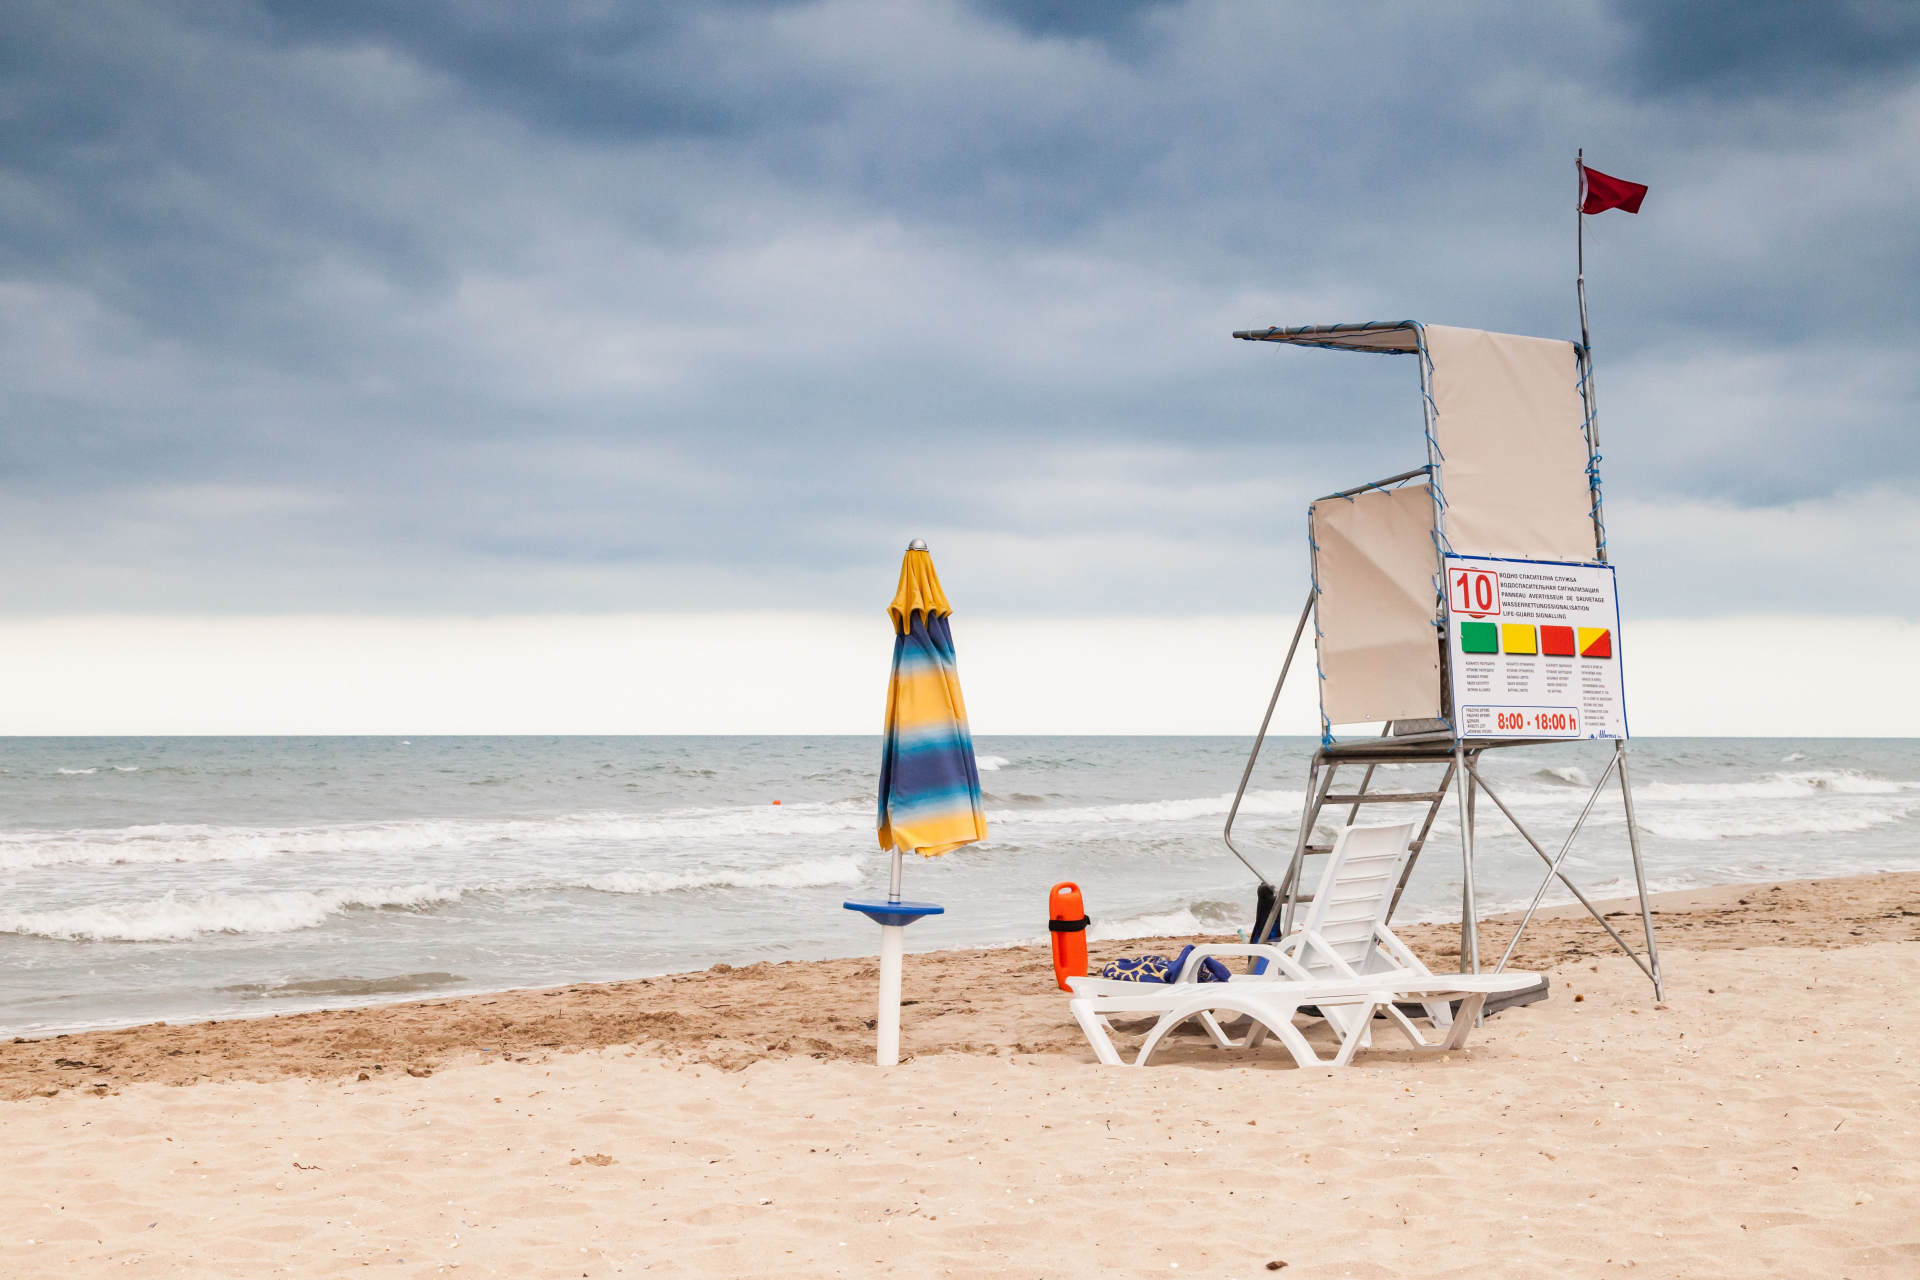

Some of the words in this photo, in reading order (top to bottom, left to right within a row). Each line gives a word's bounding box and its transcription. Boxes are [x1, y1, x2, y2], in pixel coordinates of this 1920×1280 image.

[1457, 572, 1492, 610] 10
[1501, 591, 1526, 599] PANNEAU
[1529, 593, 1564, 601] AVERTISSEUR
[1535, 612, 1567, 620] SIGNALLING
[1497, 712, 1524, 730] 8:00
[1534, 713, 1566, 730] 18:00
[1569, 713, 1577, 730] h
